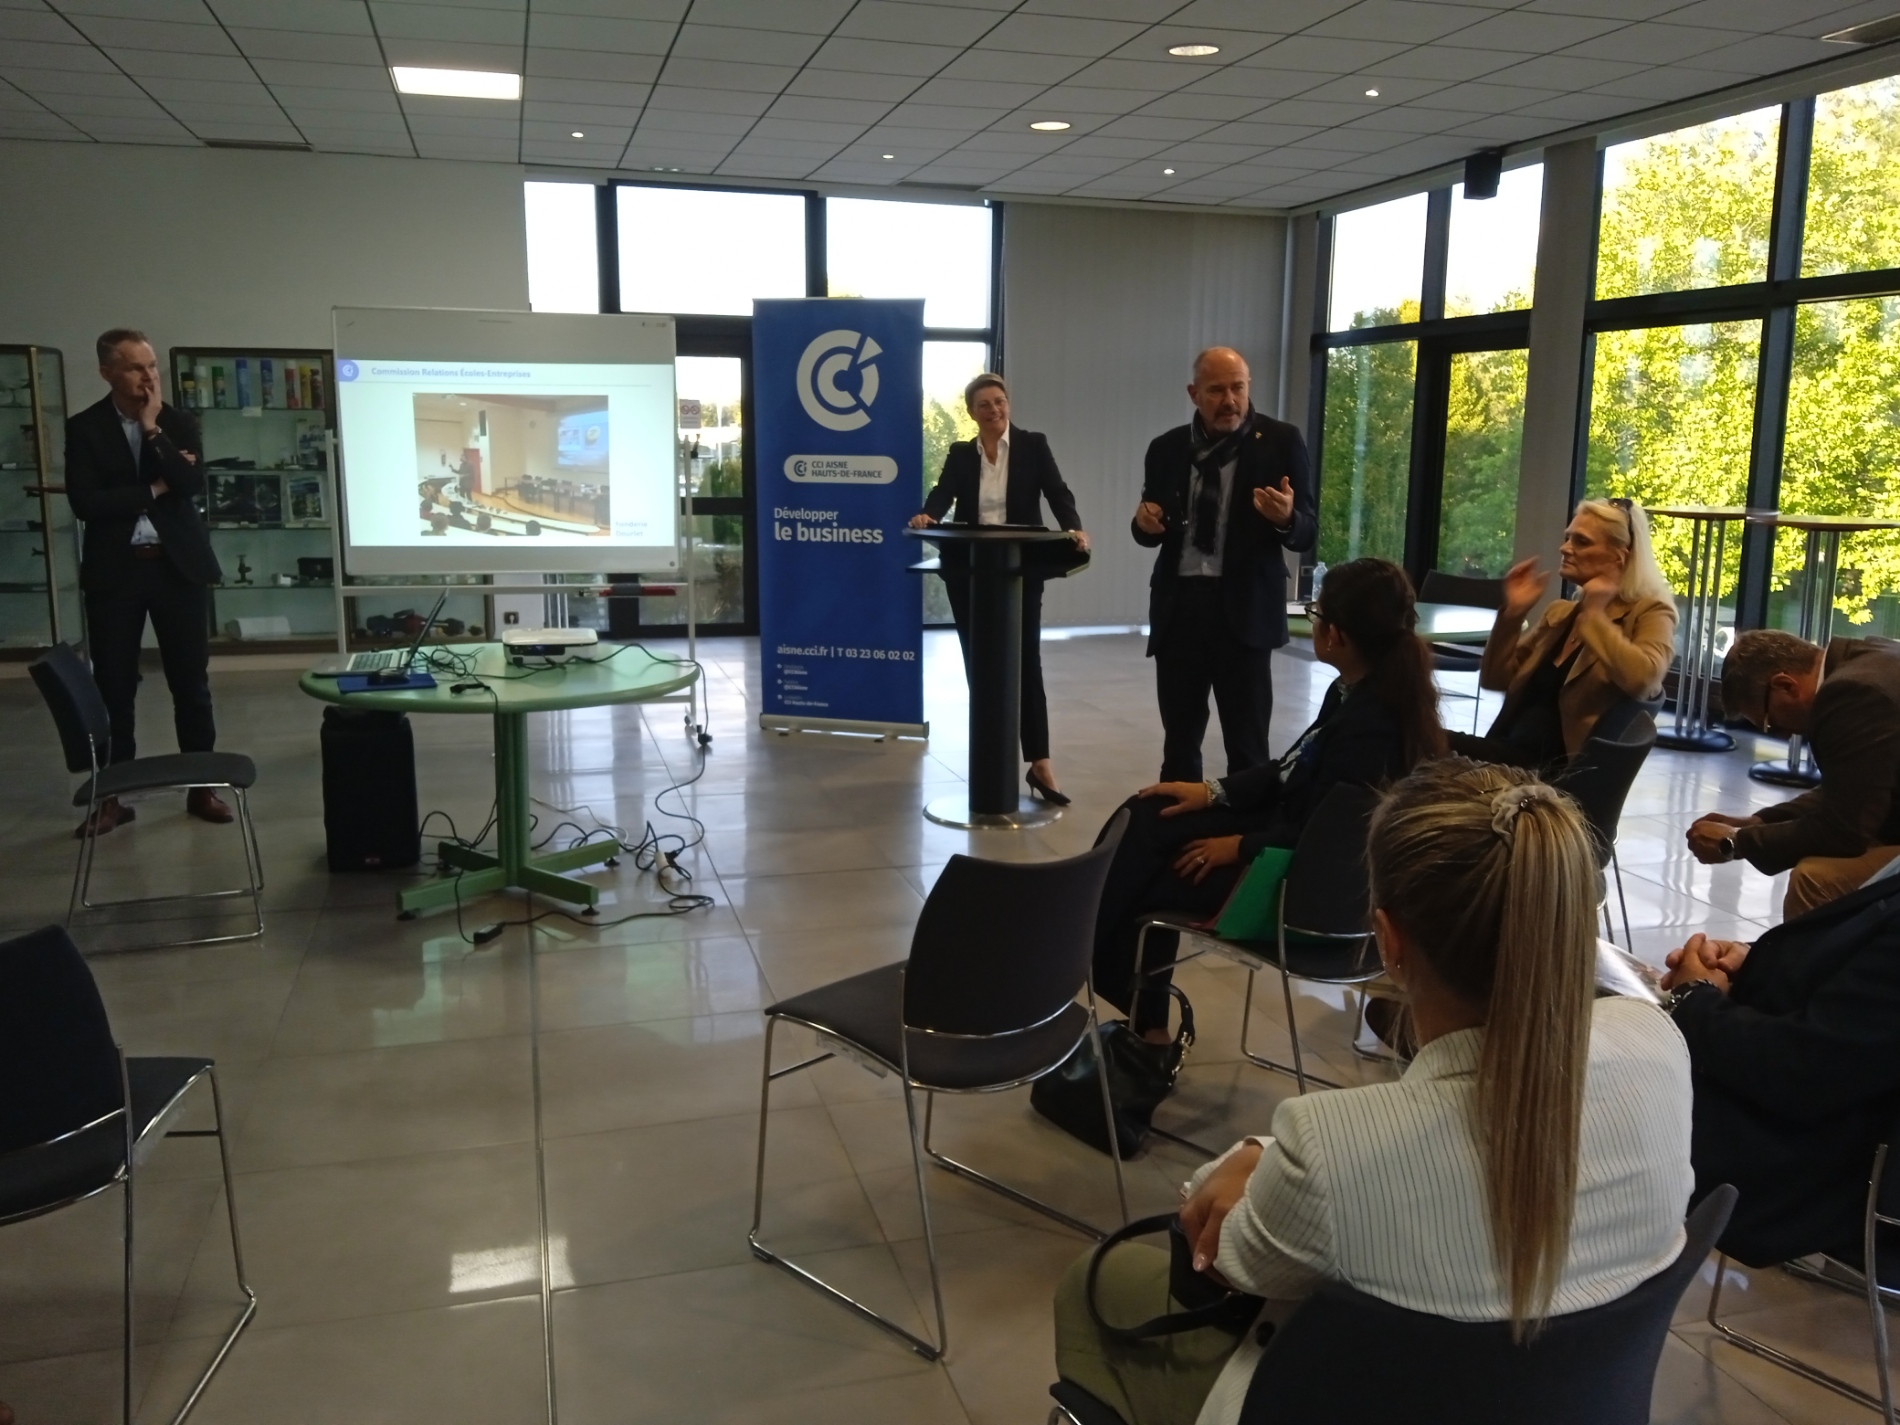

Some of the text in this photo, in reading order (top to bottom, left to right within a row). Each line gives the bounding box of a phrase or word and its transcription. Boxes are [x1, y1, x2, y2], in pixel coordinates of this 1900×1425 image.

[371, 367, 420, 376] Commission
[422, 368, 458, 377] Relations
[811, 461, 848, 469] CCI AISNE
[811, 470, 882, 478] HAUTS-DE-FRANCE
[774, 507, 839, 522] Développer
[774, 522, 884, 543] le business
[777, 644, 828, 656] aisne.cci.fr
[837, 648, 843, 656] T
[846, 649, 857, 657] 03
[860, 650, 871, 658] 23
[873, 651, 886, 659] 06
[888, 651, 900, 660] 02
[903, 652, 915, 660] 02
